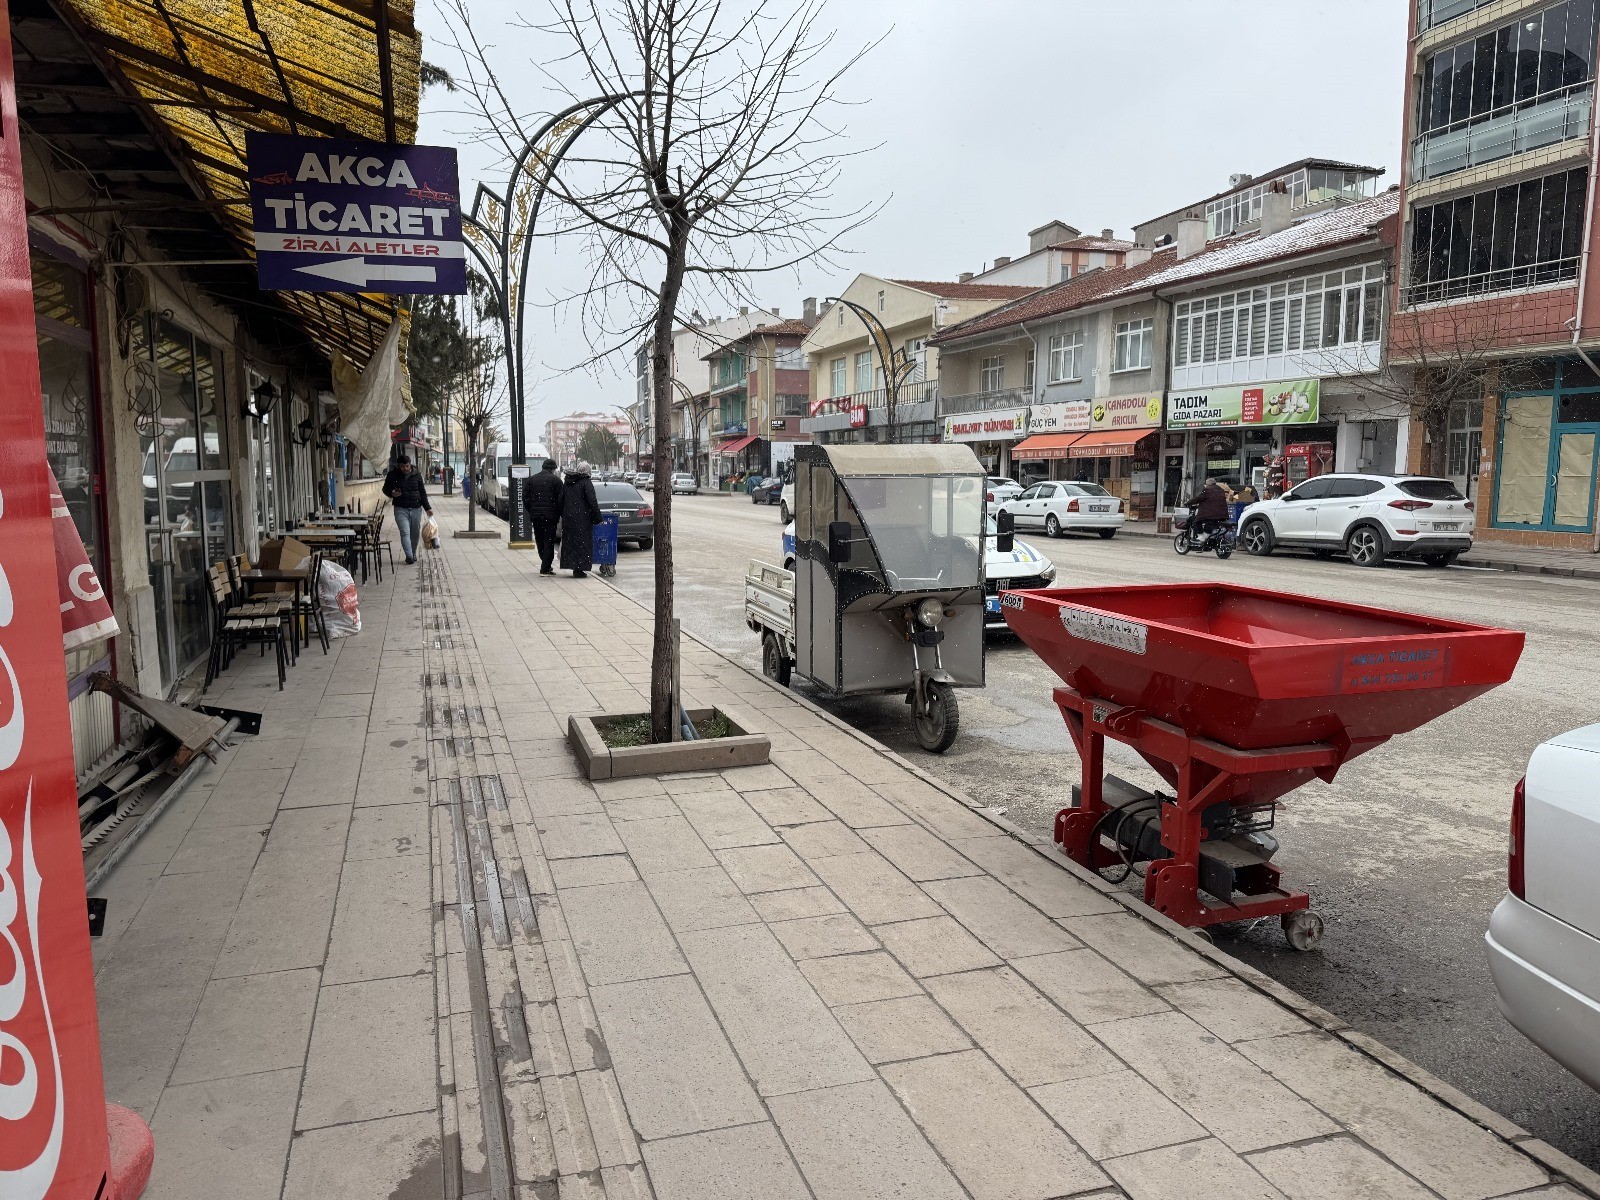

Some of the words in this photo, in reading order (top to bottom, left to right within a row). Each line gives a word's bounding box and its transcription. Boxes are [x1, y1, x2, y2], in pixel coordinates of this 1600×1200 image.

[296, 152, 417, 189] AKCA
[264, 192, 449, 236] TİCARET
[282, 237, 341, 251] ZİRAİ
[346, 241, 439, 256] ALETLER
[1174, 395, 1208, 410] TADIM
[1112, 415, 1138, 426] ARICILIK
[1173, 410, 1191, 420] GIDA
[1194, 408, 1222, 419] PAZARI
[984, 418, 1014, 431] DÜNYASI
[1044, 417, 1057, 427] YEM
[995, 579, 1011, 591] FIAT
